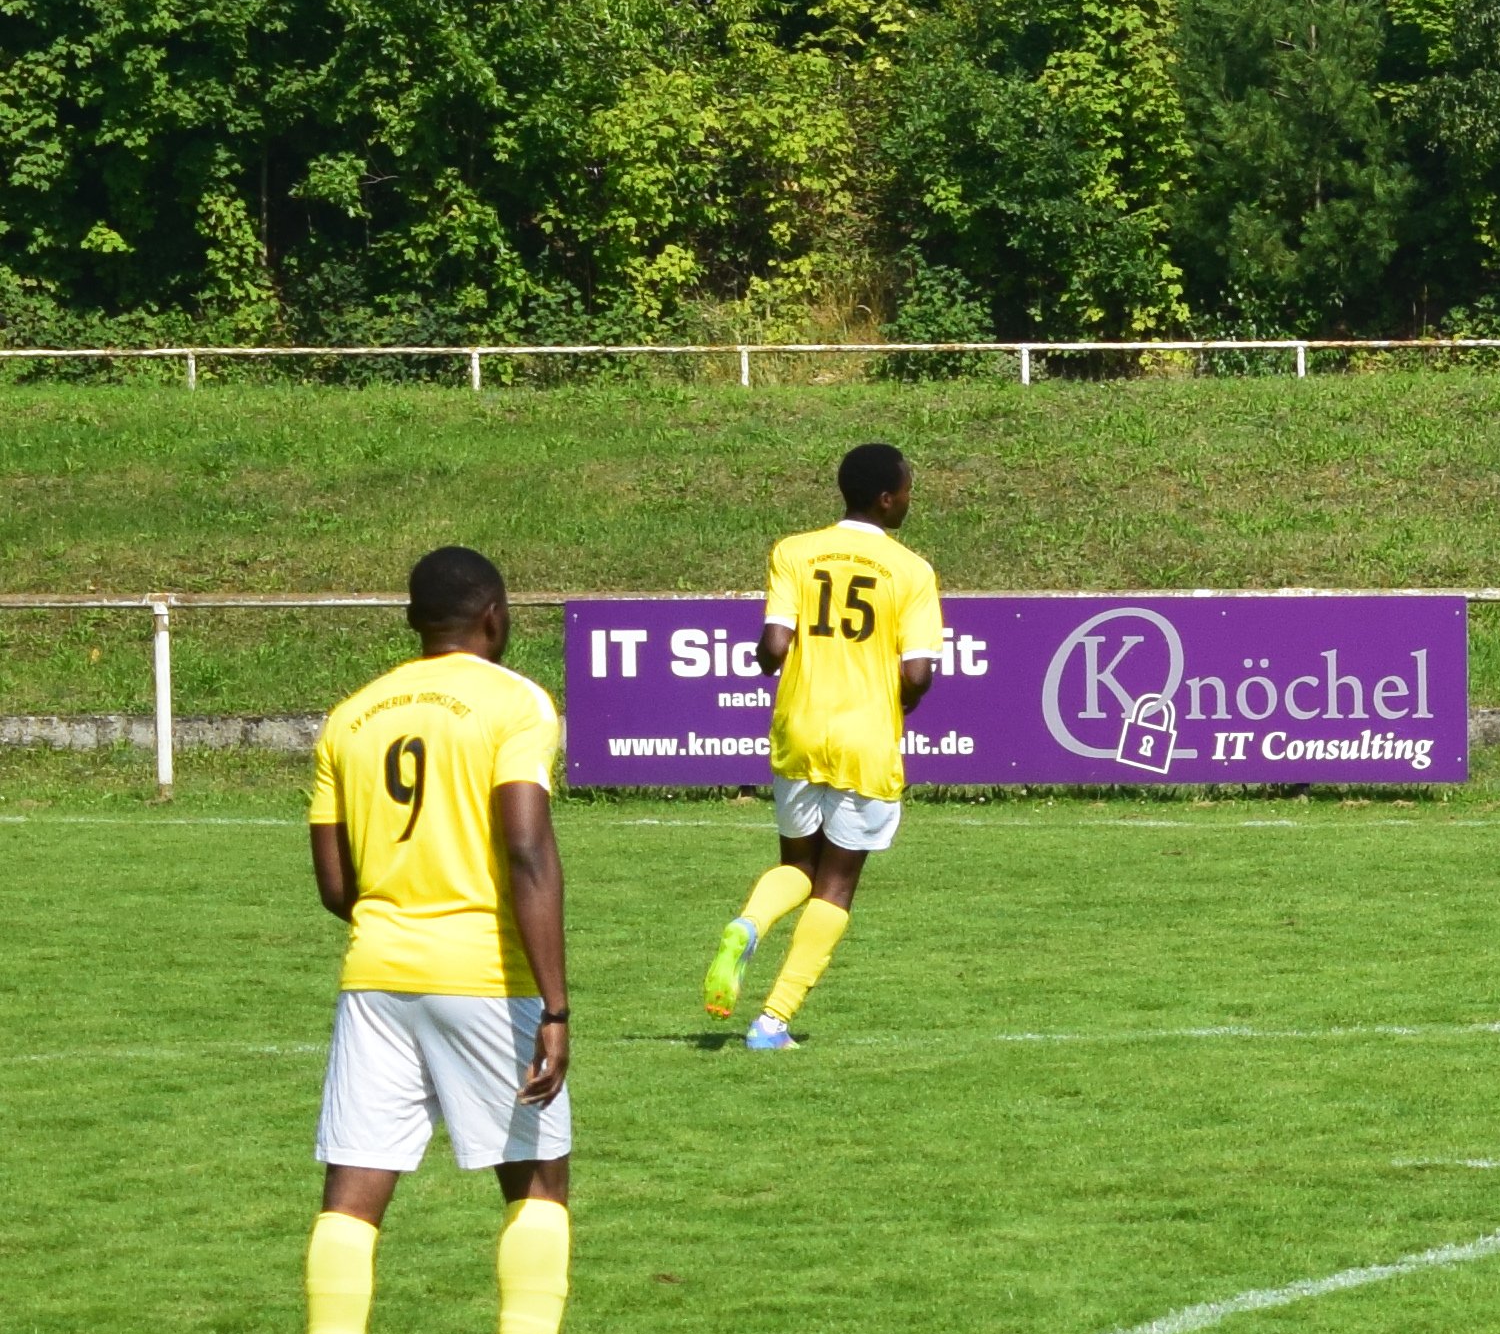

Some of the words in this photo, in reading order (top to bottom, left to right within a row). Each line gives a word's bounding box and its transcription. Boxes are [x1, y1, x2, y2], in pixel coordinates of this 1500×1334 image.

[808, 568, 877, 643] 15
[590, 629, 648, 678] IT
[670, 628, 988, 678] Sicit
[1077, 635, 1434, 720] Knöchel
[718, 688, 772, 707] nach
[1212, 732, 1254, 760] IT
[1261, 729, 1434, 769] Consulting
[384, 734, 427, 844] 9
